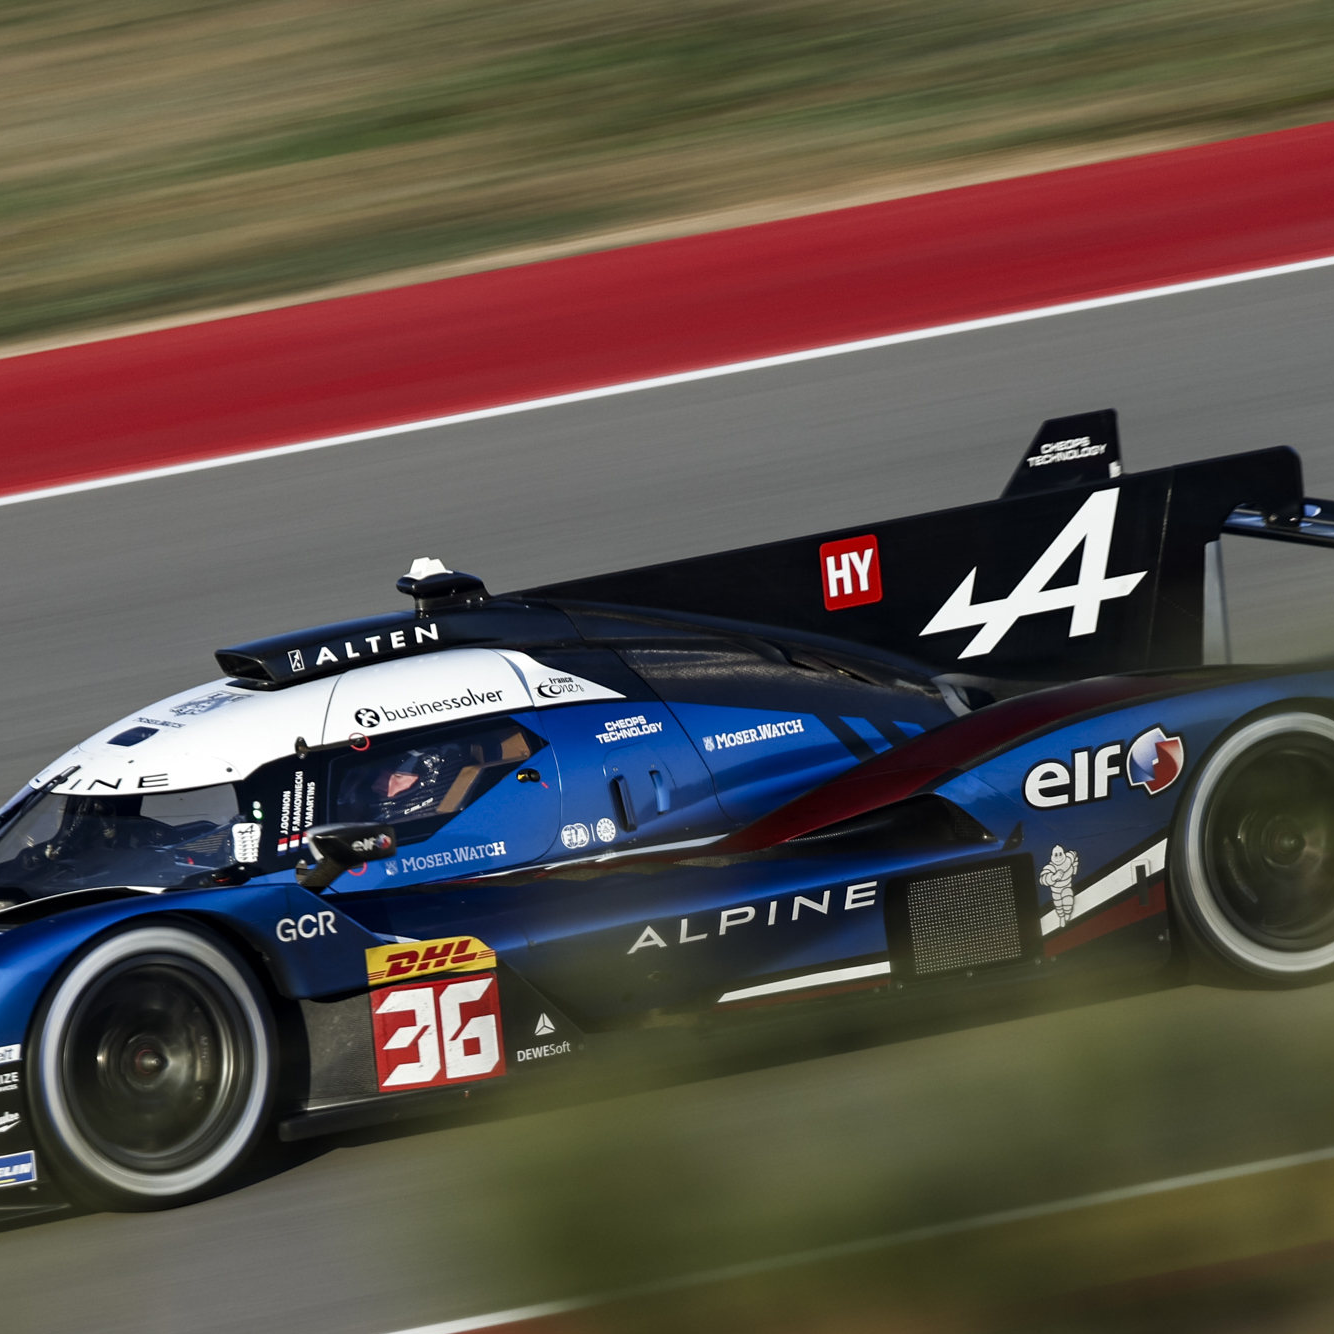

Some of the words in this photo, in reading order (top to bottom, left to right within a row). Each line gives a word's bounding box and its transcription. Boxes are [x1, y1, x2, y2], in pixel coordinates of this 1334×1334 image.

[1026, 443, 1108, 468] TECHNOLOGY
[1040, 436, 1091, 454] CHEOPS
[825, 548, 873, 598] HY
[316, 623, 439, 665] ALTEN
[380, 688, 503, 722] businessolver
[595, 722, 663, 744] TECHNOLOGY
[604, 715, 647, 731] CHEOPS
[1024, 744, 1120, 808] elf
[351, 837, 376, 851] elf
[276, 910, 337, 942] GCR
[627, 881, 877, 955] ALPINE
[385, 938, 479, 978] DHL
[374, 977, 500, 1087] 36
[517, 1041, 571, 1062] DEWESoft
